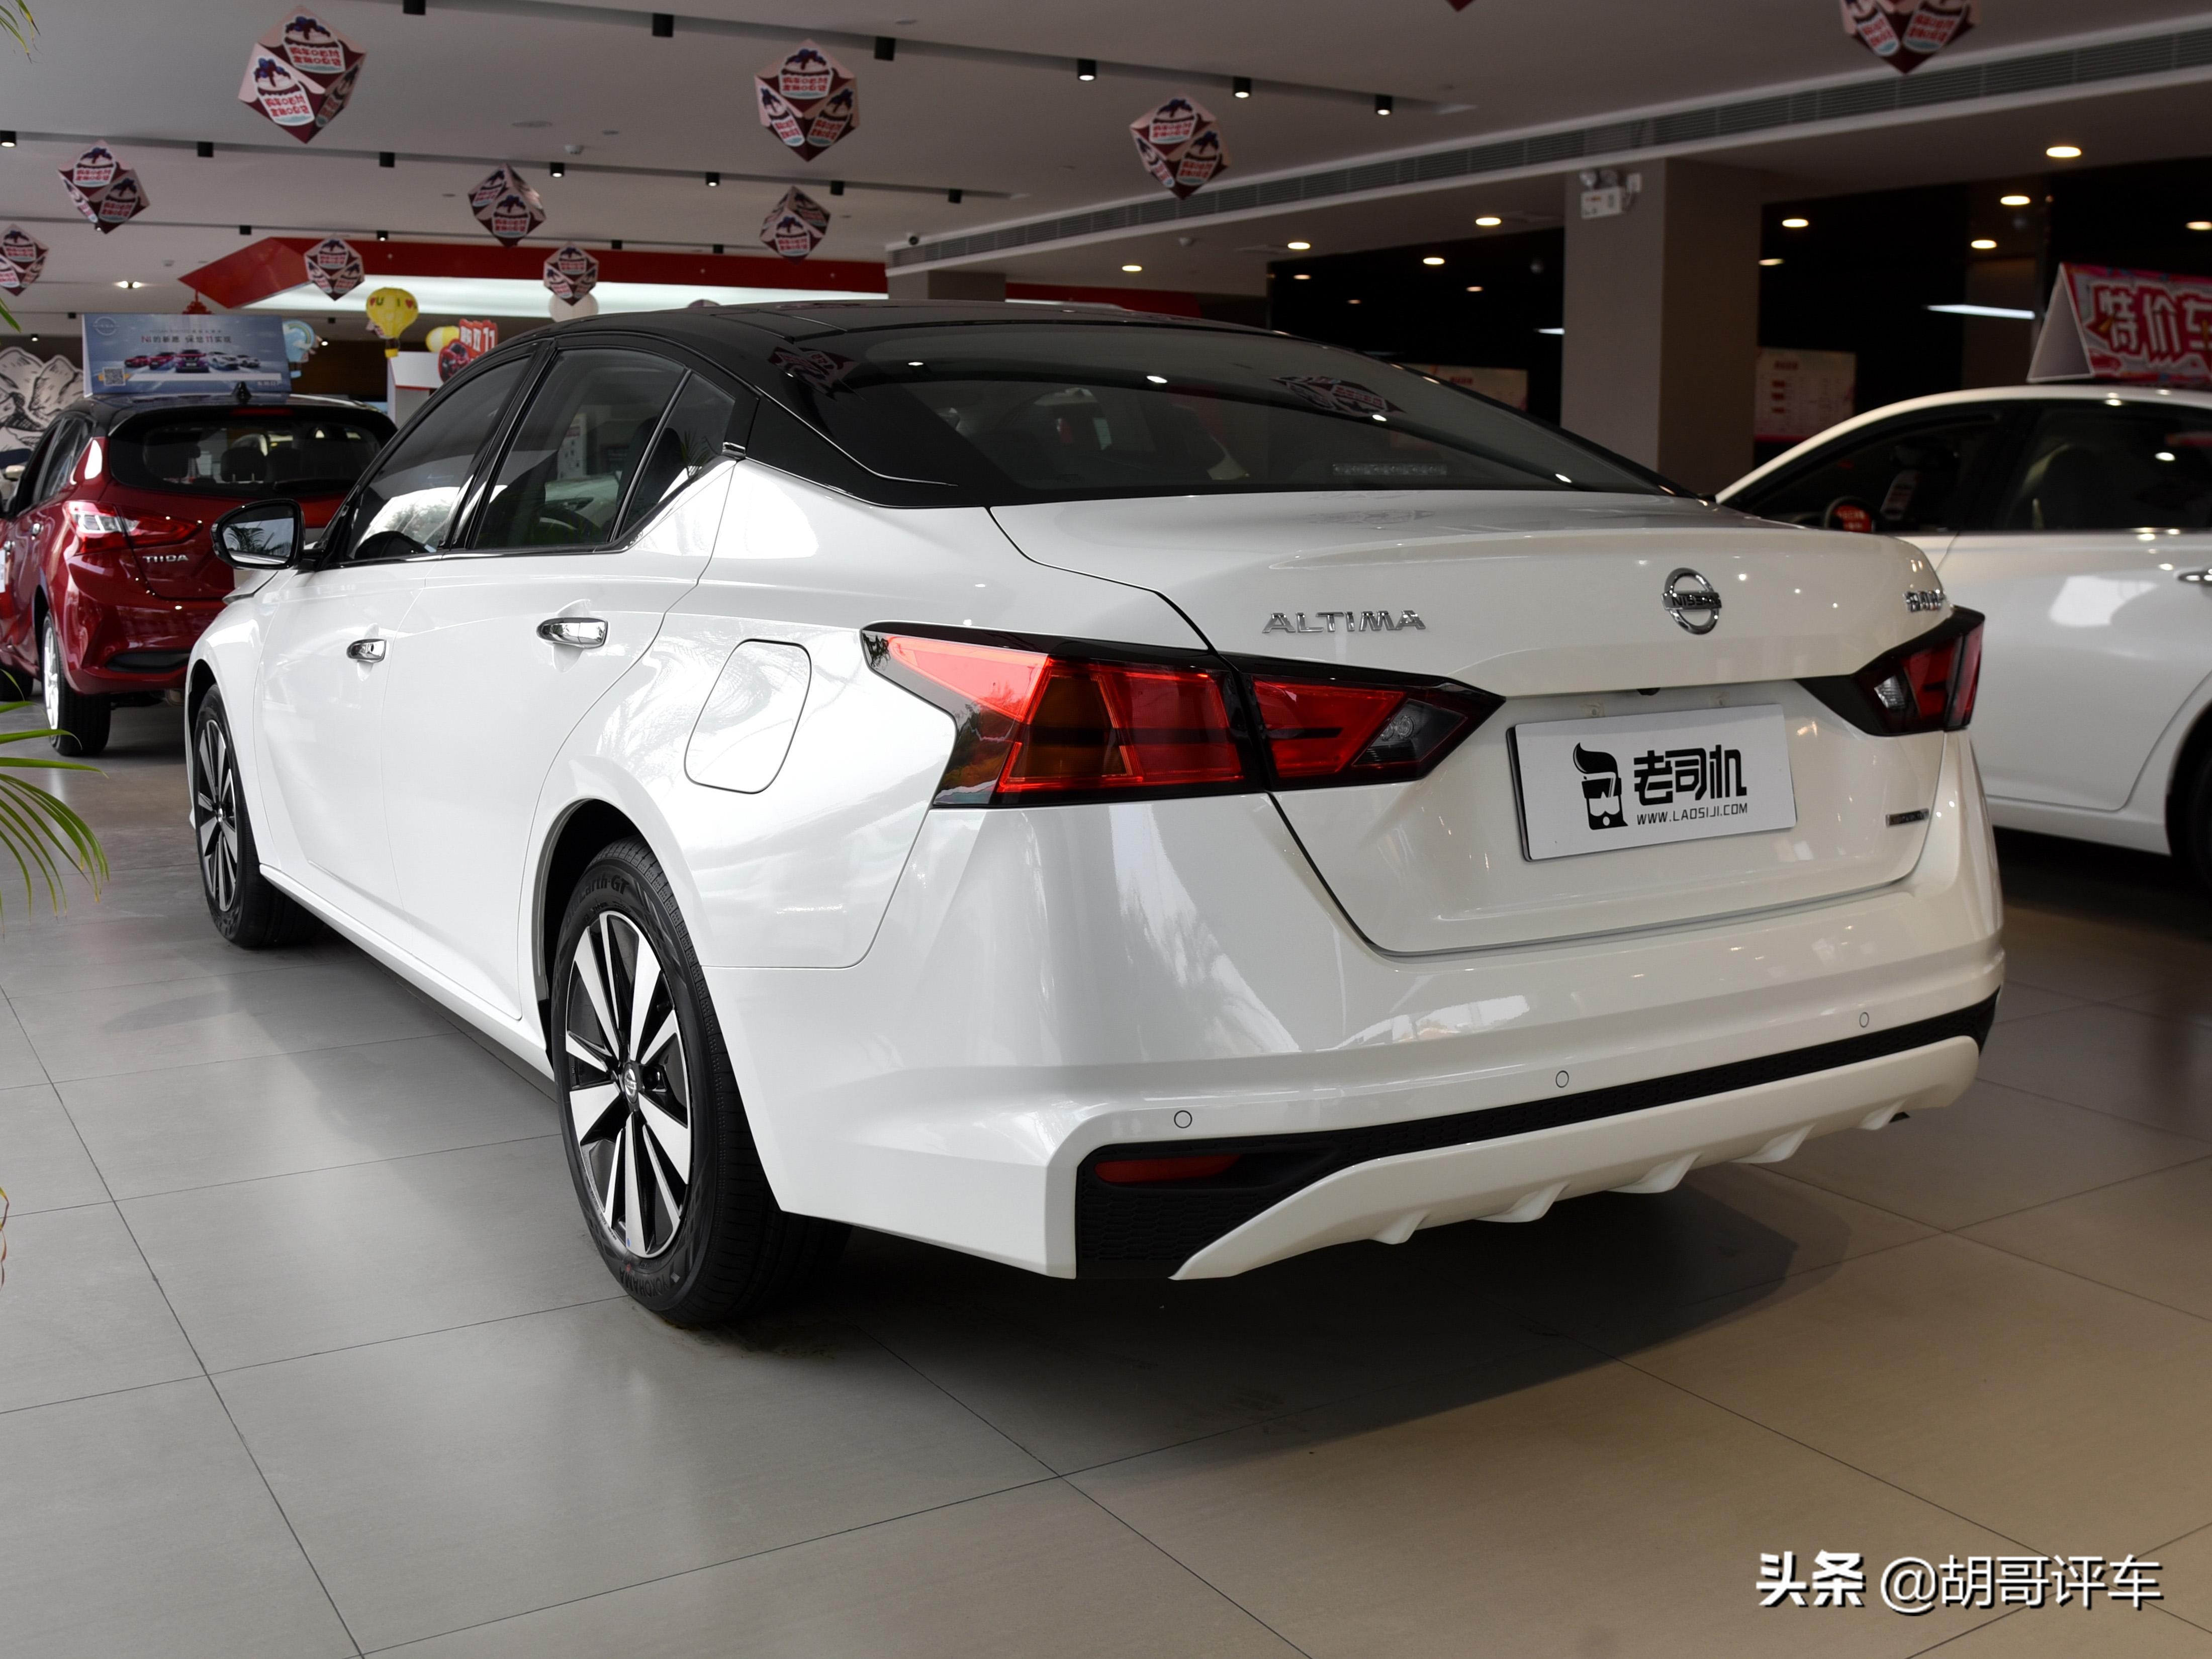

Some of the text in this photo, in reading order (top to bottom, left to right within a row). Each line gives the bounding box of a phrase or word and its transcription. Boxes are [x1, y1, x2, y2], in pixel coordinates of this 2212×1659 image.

[2097, 290, 2212, 353] 特价车
[142, 554, 190, 564] TIIDA
[1262, 610, 1426, 633] ALTIMA
[1633, 745, 1747, 806] 老司机
[1637, 803, 1748, 825] WWW.LAOSIJI.COM
